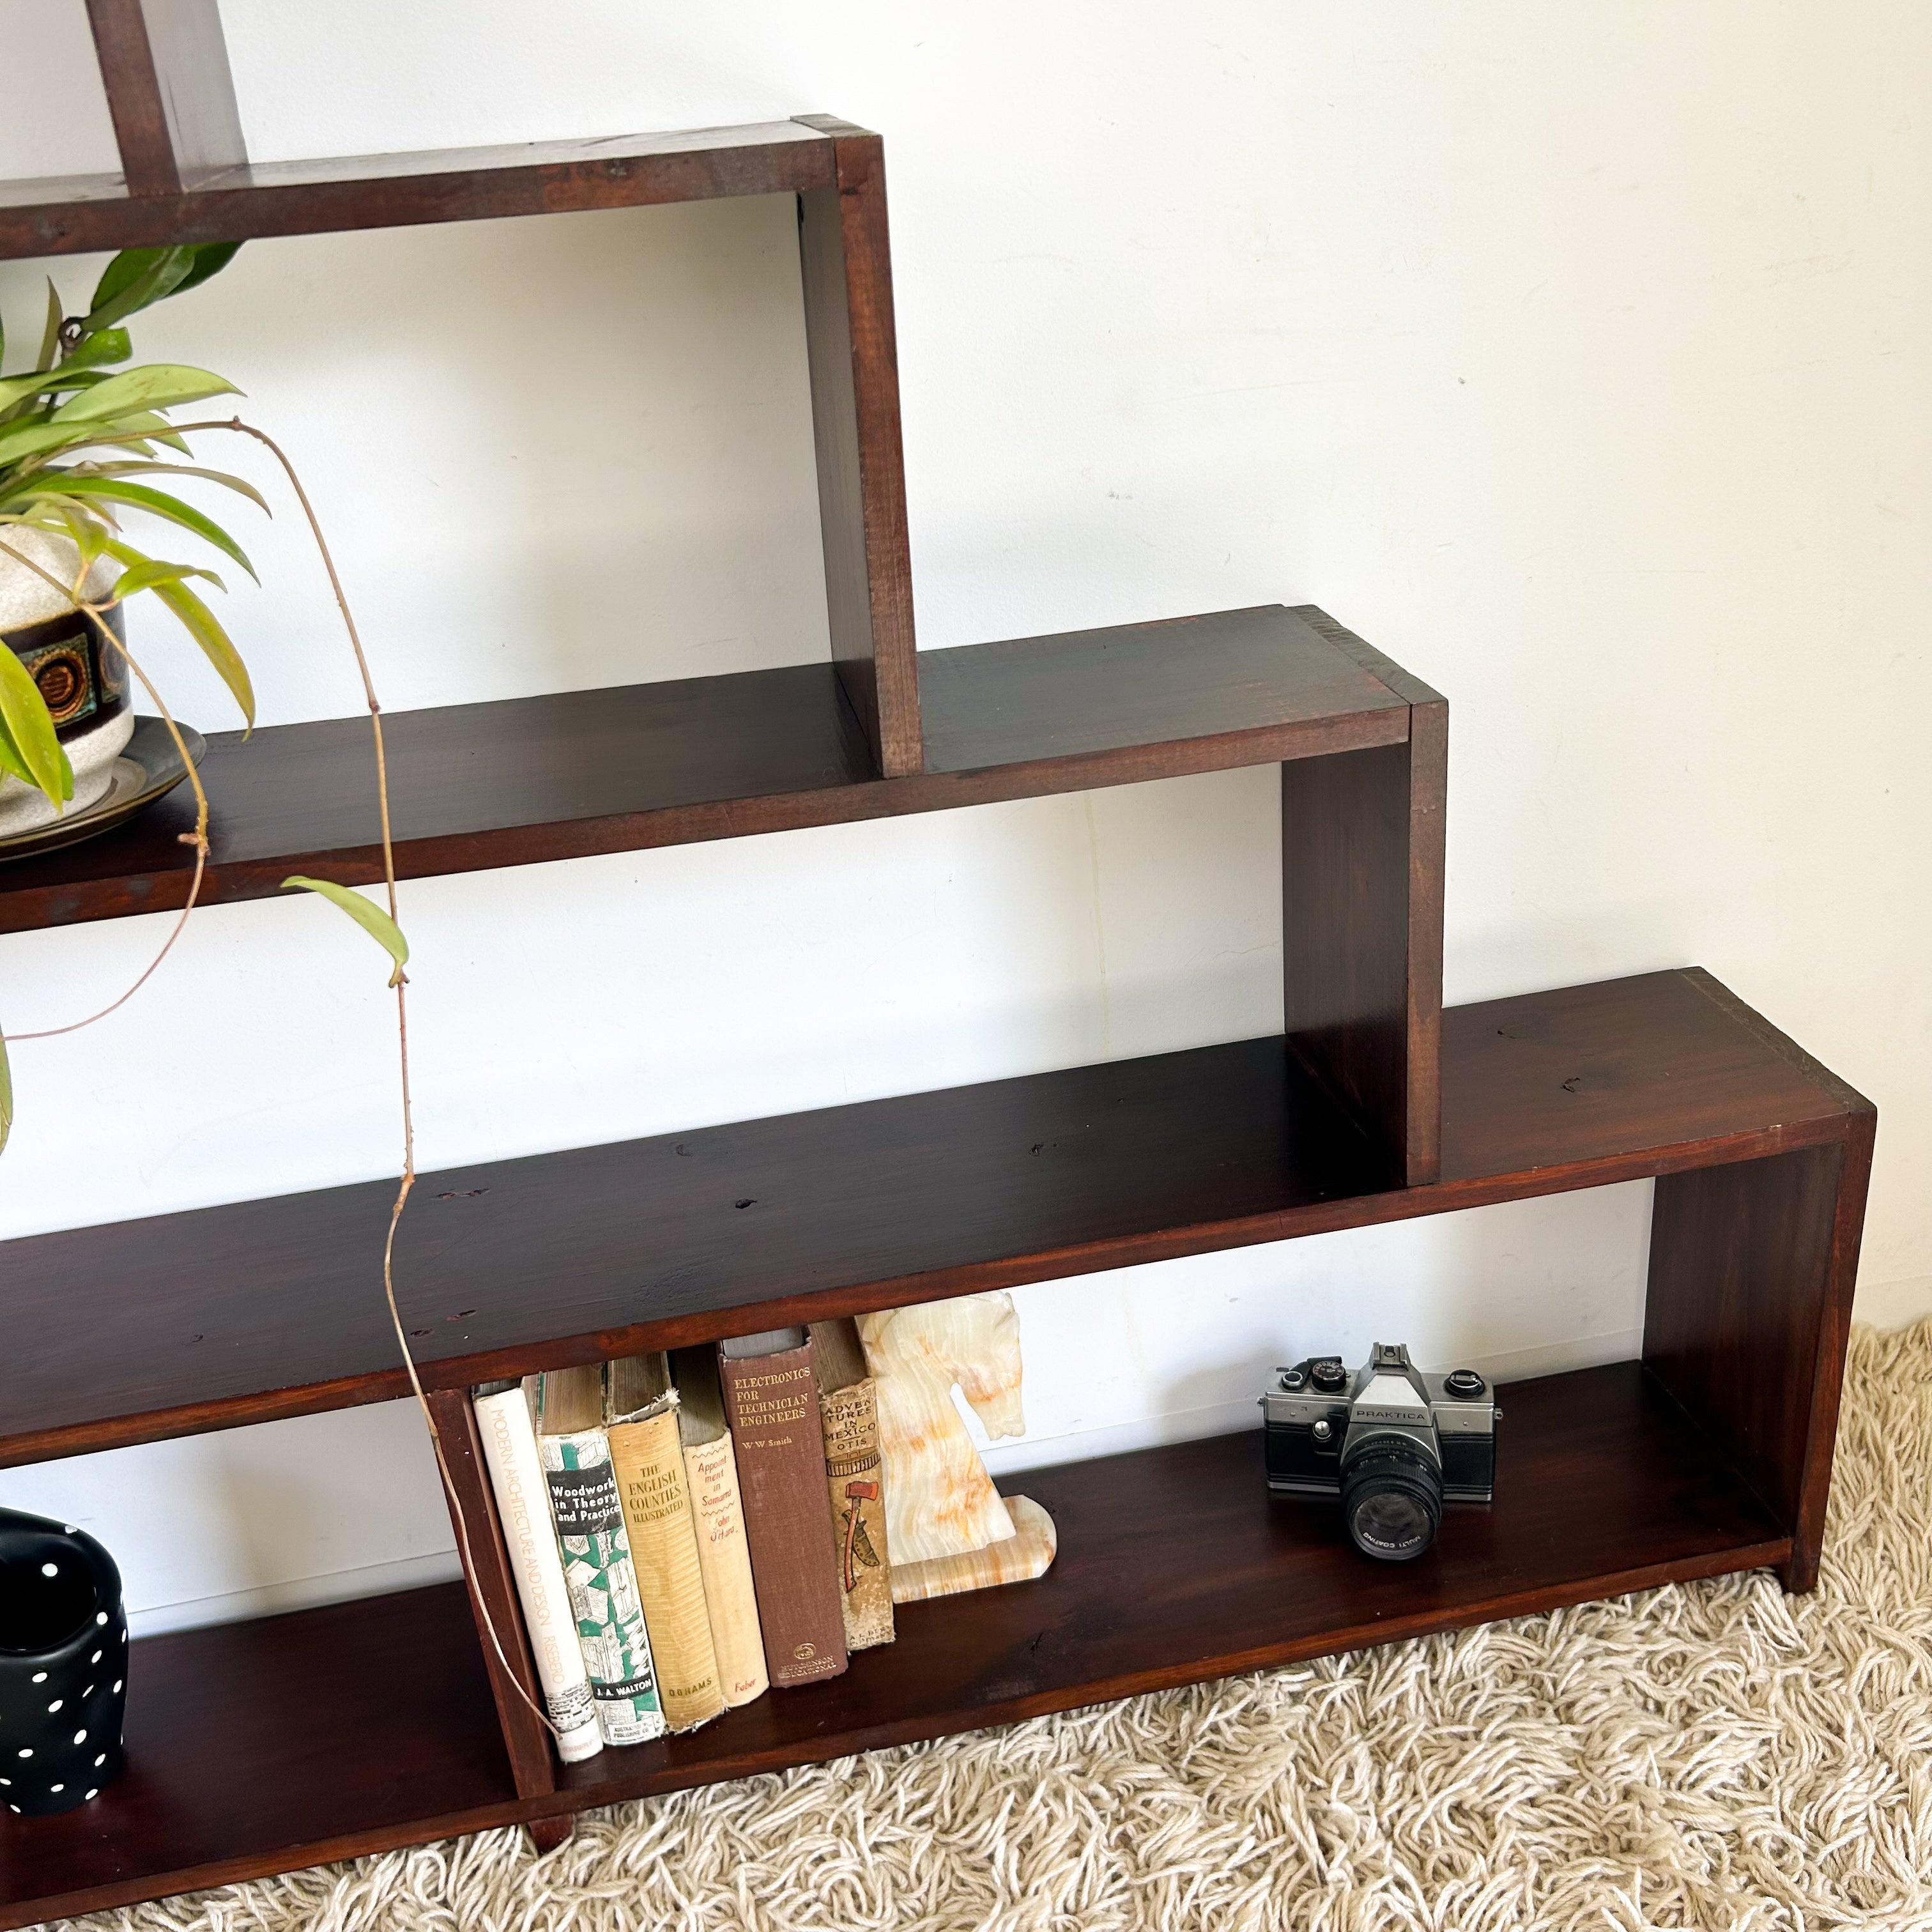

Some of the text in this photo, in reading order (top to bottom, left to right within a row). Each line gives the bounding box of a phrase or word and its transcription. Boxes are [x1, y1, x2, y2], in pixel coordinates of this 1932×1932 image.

[734, 1367, 810, 1389] ELECTRONICS
[736, 1390, 759, 1402] FOR
[737, 1393, 808, 1414] TECHNICIAN
[739, 1407, 806, 1427] ENGINEERS
[826, 1406, 872, 1423] TURES
[844, 1419, 857, 1428] IN
[1357, 1410, 1425, 1420] PRAKTICA
[824, 1422, 875, 1441] MEXICO
[768, 1436, 792, 1446] Smith
[838, 1438, 866, 1450] OTIS
[640, 1463, 661, 1478] THE
[705, 1471, 724, 1483] ment
[551, 1477, 616, 1498] Woodwork
[629, 1469, 677, 1496] ENGLISH
[714, 1483, 721, 1492] in
[555, 1492, 617, 1510] in Theory
[629, 1483, 682, 1510] COUNTIES
[558, 1504, 620, 1522] and Practice
[633, 1499, 684, 1523] ILLUSTRATED
[491, 1409, 565, 1683] MODERN ARCHITECTURE AND DESIGN RISEBERO
[1363, 1532, 1421, 1548] MULTI COATING
[606, 1687, 614, 1696] A.
[616, 1678, 652, 1696] WALTON
[735, 1678, 756, 1692] Faber
